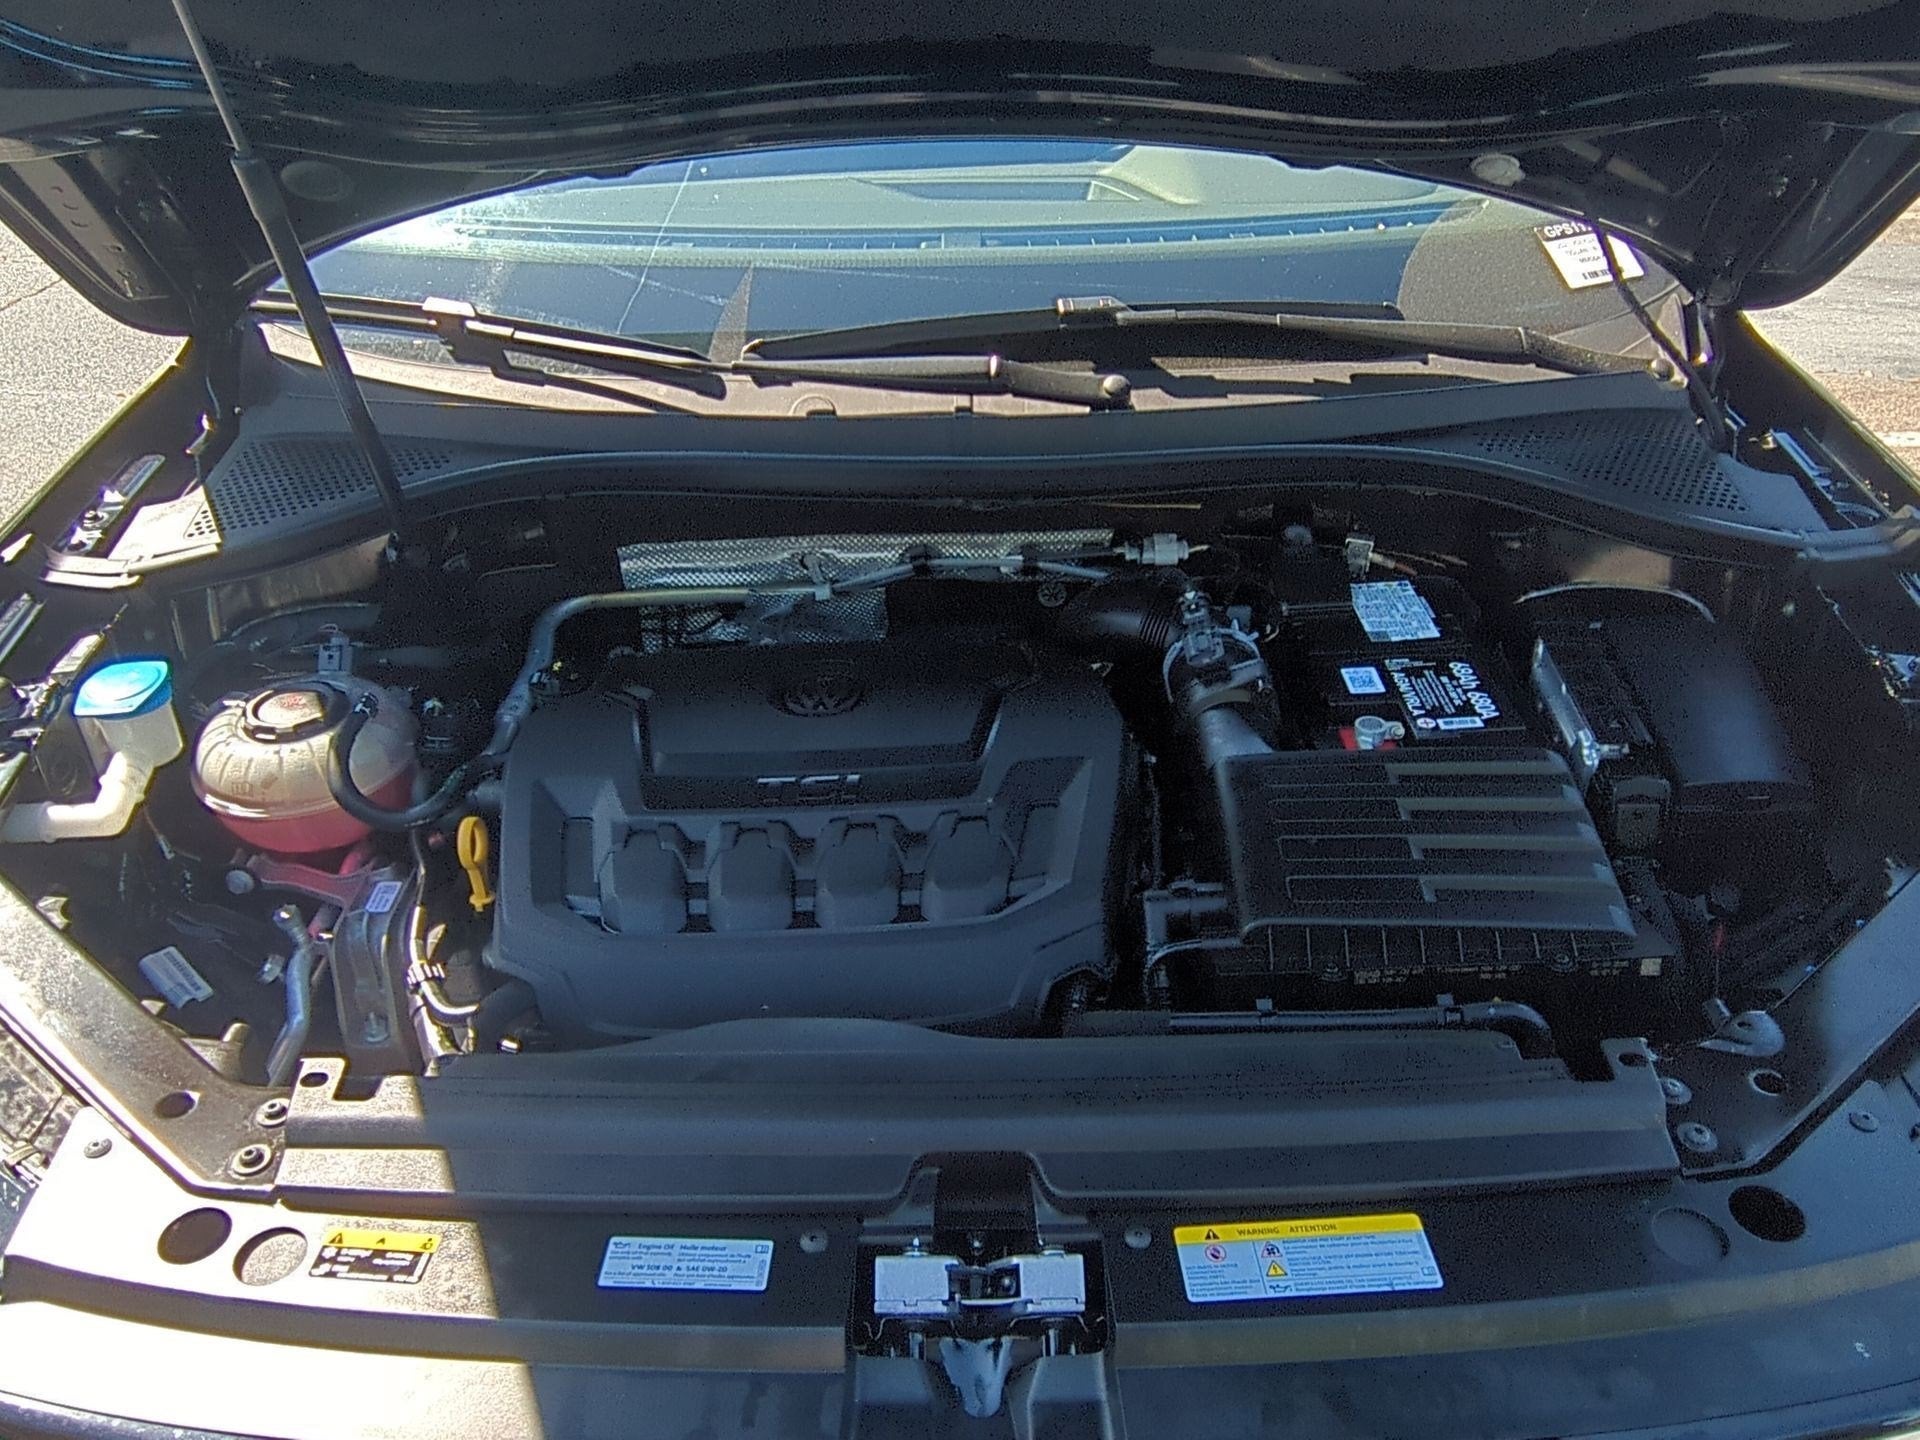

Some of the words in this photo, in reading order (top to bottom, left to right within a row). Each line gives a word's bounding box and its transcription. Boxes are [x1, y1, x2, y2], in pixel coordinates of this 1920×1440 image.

[1236, 1227, 1281, 1237] WARNING
[1289, 1223, 1338, 1233] ATTENTION
[638, 1243, 662, 1251] Engine
